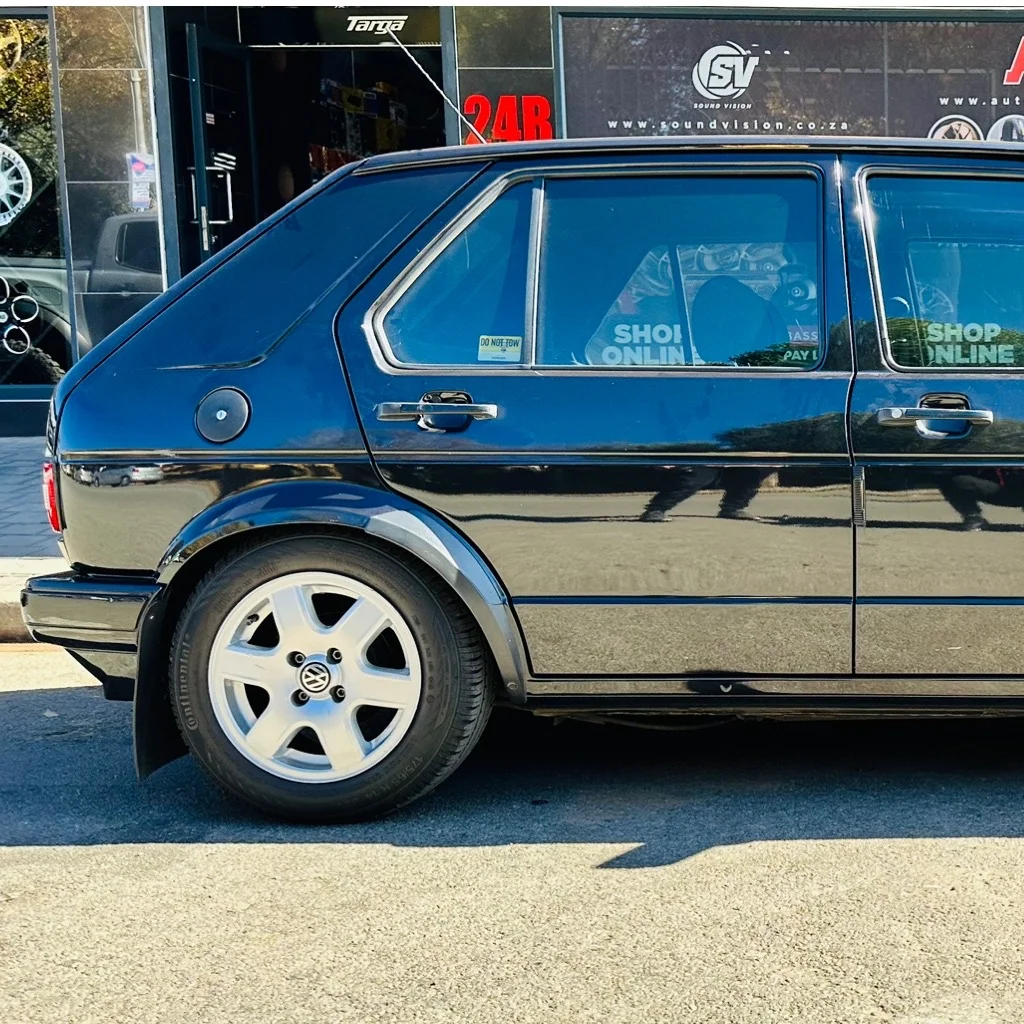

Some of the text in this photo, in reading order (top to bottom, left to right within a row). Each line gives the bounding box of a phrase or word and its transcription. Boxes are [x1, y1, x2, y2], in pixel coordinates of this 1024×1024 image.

[346, 15, 409, 34] Targa
[608, 119, 848, 130] www.soundvision.co.za
[927, 323, 1002, 343] SHOP
[480, 338, 520, 348] DO NOT TOW
[602, 346, 686, 365] ONLIN
